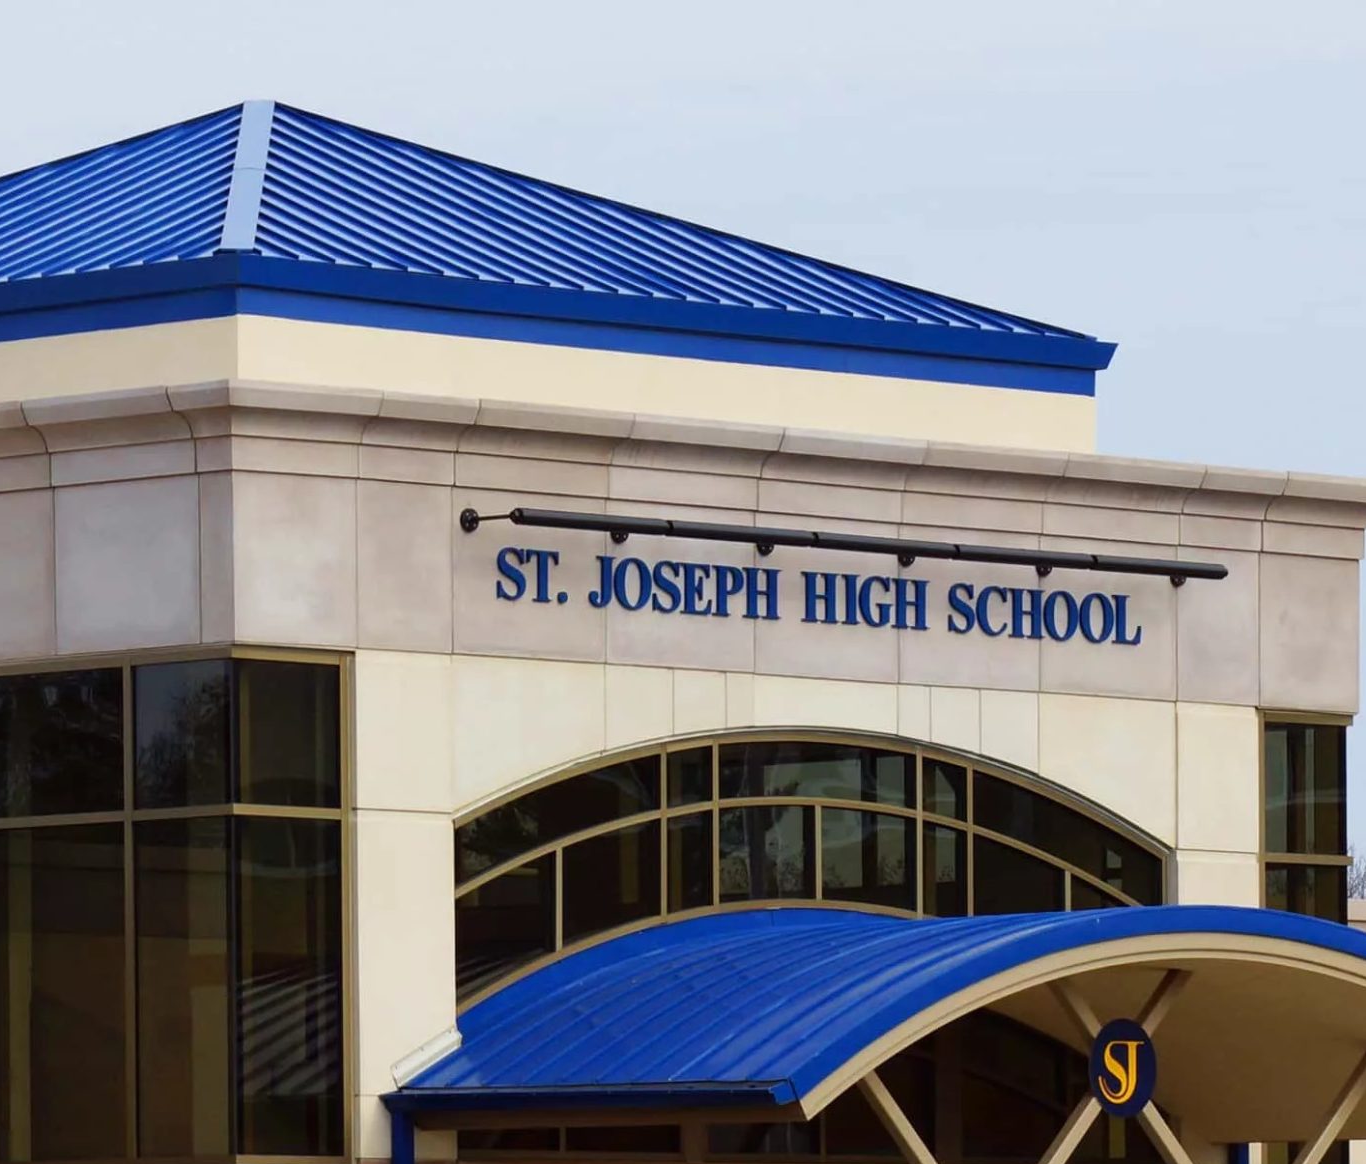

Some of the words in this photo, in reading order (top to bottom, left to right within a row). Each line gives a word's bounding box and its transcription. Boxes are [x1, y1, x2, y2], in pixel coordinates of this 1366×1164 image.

[496, 547, 568, 603] ST.
[588, 555, 780, 620] JOSEPH
[801, 571, 929, 630] HIGH
[947, 583, 1142, 645] SCHOOL
[1098, 1040, 1144, 1104] SJ
